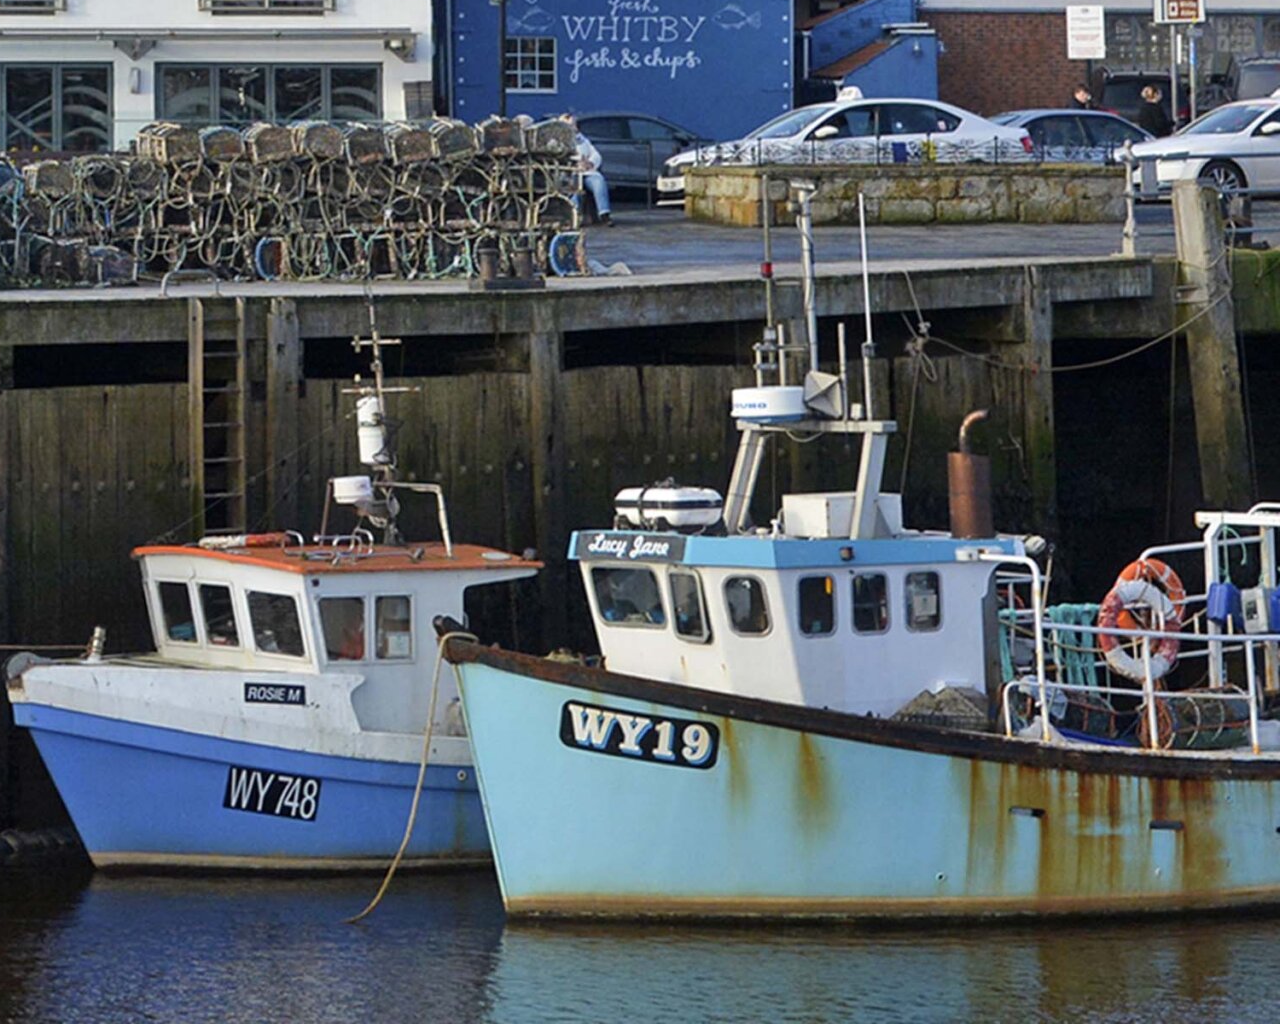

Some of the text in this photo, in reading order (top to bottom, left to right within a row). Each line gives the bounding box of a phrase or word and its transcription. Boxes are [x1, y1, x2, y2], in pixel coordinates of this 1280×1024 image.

[561, 15, 706, 42] WHITBY
[564, 46, 702, 83] fish & chips
[588, 533, 669, 559] Lucy Jane
[247, 686, 302, 702] ROSIE M
[567, 703, 713, 766] WY19
